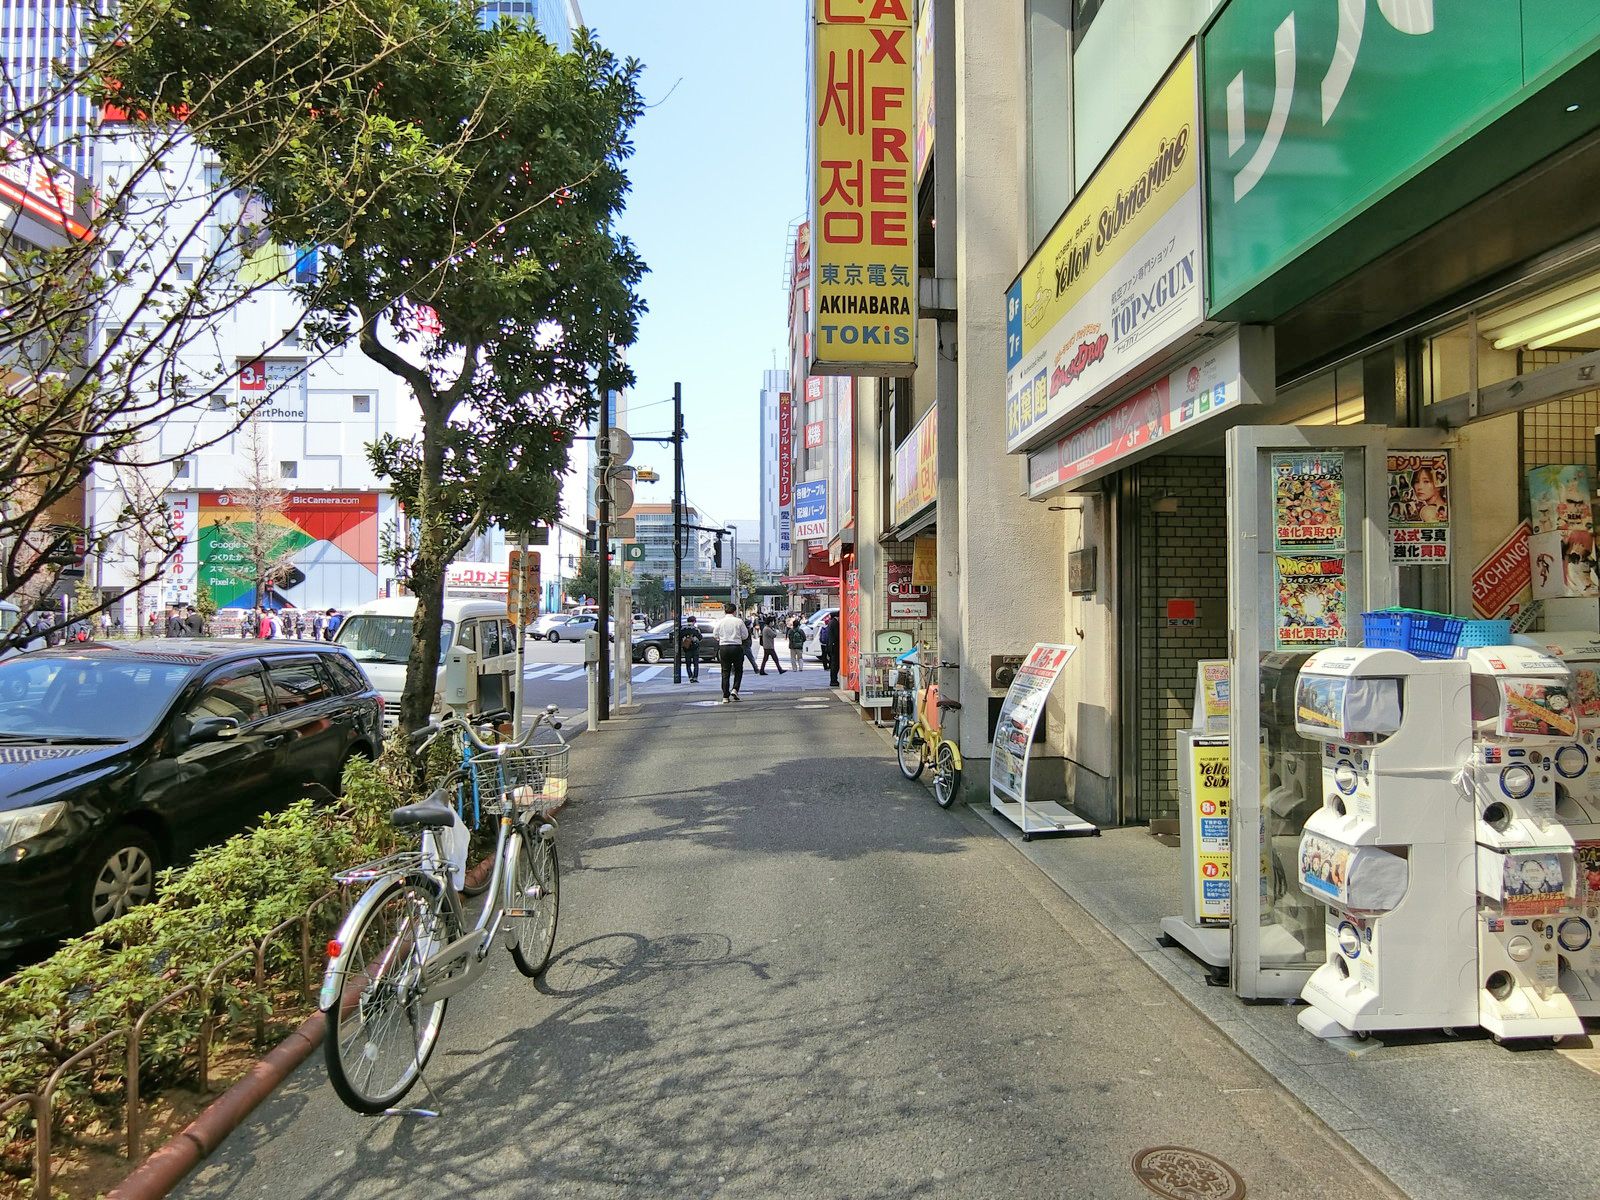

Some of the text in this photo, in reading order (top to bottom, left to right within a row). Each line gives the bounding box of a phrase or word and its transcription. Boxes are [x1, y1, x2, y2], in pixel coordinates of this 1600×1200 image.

[870, 86, 910, 246] FREE
[1055, 238, 1092, 298] Yellow
[1096, 128, 1188, 252] Submarine
[1075, 214, 1091, 240] BASE
[820, 263, 910, 287] 東京電気
[819, 295, 911, 315] AKIHABARA
[1008, 297, 1020, 322] 8F
[1008, 333, 1020, 358] 7F
[241, 367, 264, 385] 3F
[240, 396, 273, 405] Audio
[1008, 375, 1048, 436] 秋葉館
[1061, 415, 1112, 467] amiami
[293, 496, 360, 504] BicCamera.com
[173, 498, 188, 530] Tax
[780, 511, 790, 551] 愛三電機
[797, 522, 825, 537] AISAN
[1394, 529, 1447, 542] 公式写真
[210, 540, 241, 551] Google
[1394, 545, 1447, 558] 強化買取
[1277, 556, 1344, 575] DRAGON BALL
[210, 577, 237, 586] Pixel 4
[888, 582, 930, 596] GUILD
[1202, 802, 1215, 813] 8F
[1205, 864, 1217, 876] 7F
